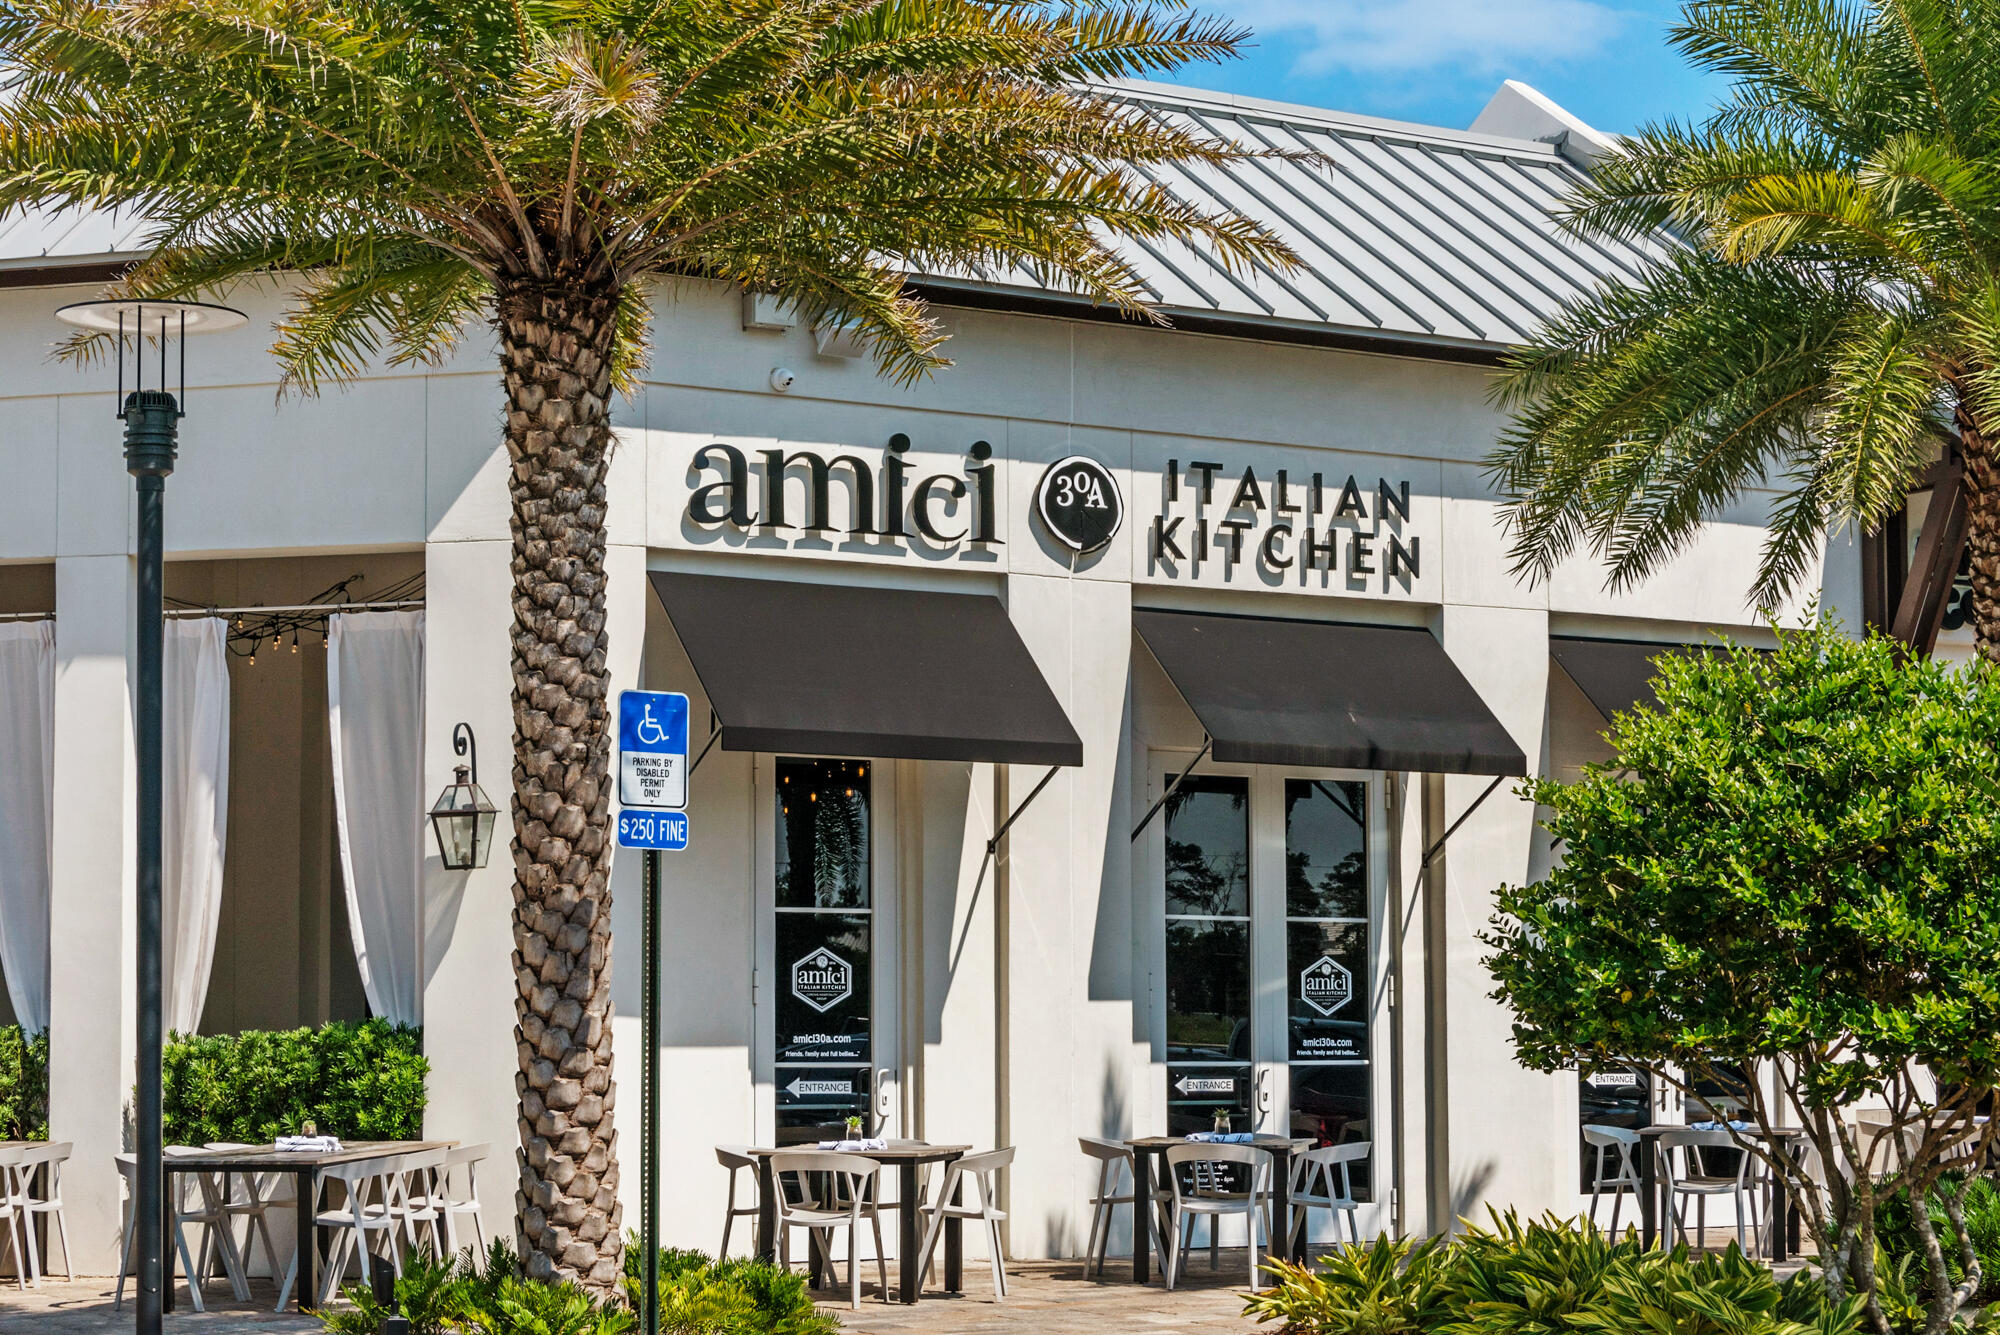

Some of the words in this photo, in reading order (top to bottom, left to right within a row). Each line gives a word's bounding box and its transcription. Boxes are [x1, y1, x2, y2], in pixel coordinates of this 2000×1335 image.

[688, 432, 1006, 544] amici
[1167, 459, 1410, 524] ITALIAN
[1154, 515, 1420, 579] KITCHEN
[632, 757, 662, 767] PARKING
[664, 759, 674, 768] BY
[636, 767, 670, 778] DISABLED
[640, 778, 665, 788] PERMIT
[643, 788, 662, 798] ONLY
[620, 818, 655, 842] $250
[659, 820, 686, 842] FINE
[798, 967, 846, 985] amici
[1306, 974, 1347, 990] amici
[793, 1033, 852, 1044] amici30a.com
[1302, 1037, 1353, 1047] amici30a.com
[805, 1050, 820, 1059] family
[1186, 1080, 1232, 1090] ENTRANCE
[1595, 1075, 1635, 1084] ENTRANCE
[799, 1083, 850, 1092] ENTRANCE
